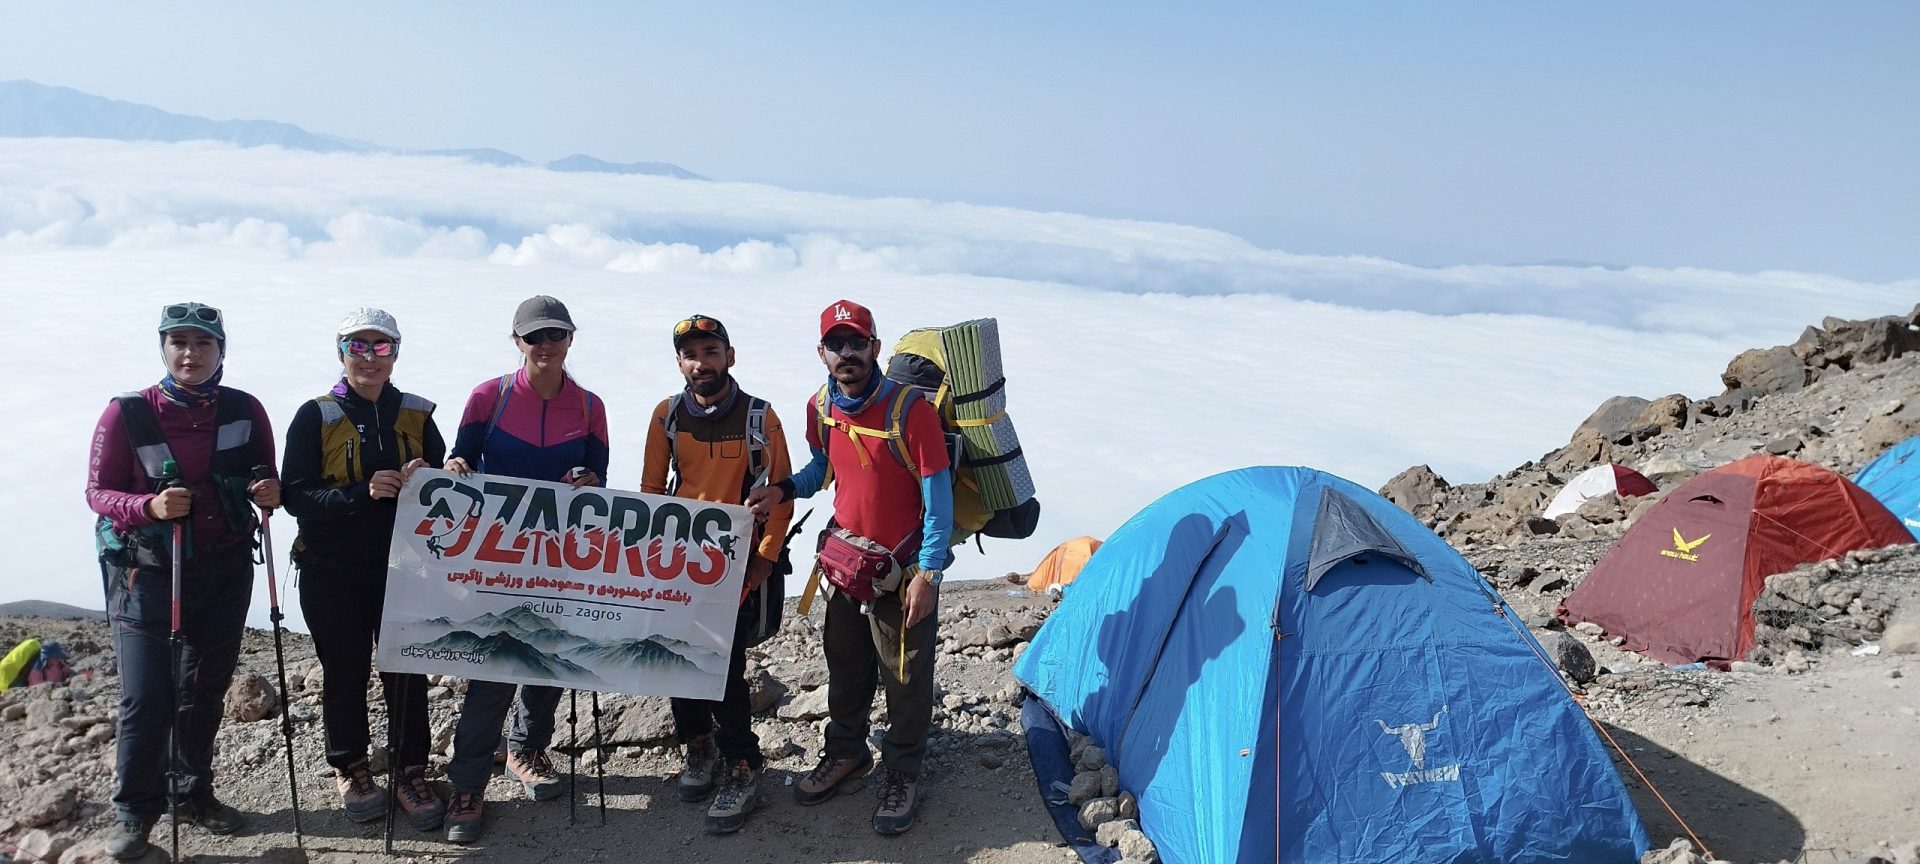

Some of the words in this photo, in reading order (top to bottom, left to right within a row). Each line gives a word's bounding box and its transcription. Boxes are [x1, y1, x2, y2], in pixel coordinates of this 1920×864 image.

[835, 304, 851, 321] LA
[474, 482, 733, 586] ZAGROS
[447, 568, 483, 585] زاگرس
[485, 571, 523, 588] ورزشی
[525, 575, 584, 592] صعودهای
[587, 584, 594, 595] و
[596, 585, 653, 602] کوهنوردی
[655, 588, 692, 605] باشگاه
[521, 601, 570, 617] @club_
[575, 606, 622, 621] zagros
[434, 647, 461, 661] ورزش
[461, 652, 485, 664] وزارت
